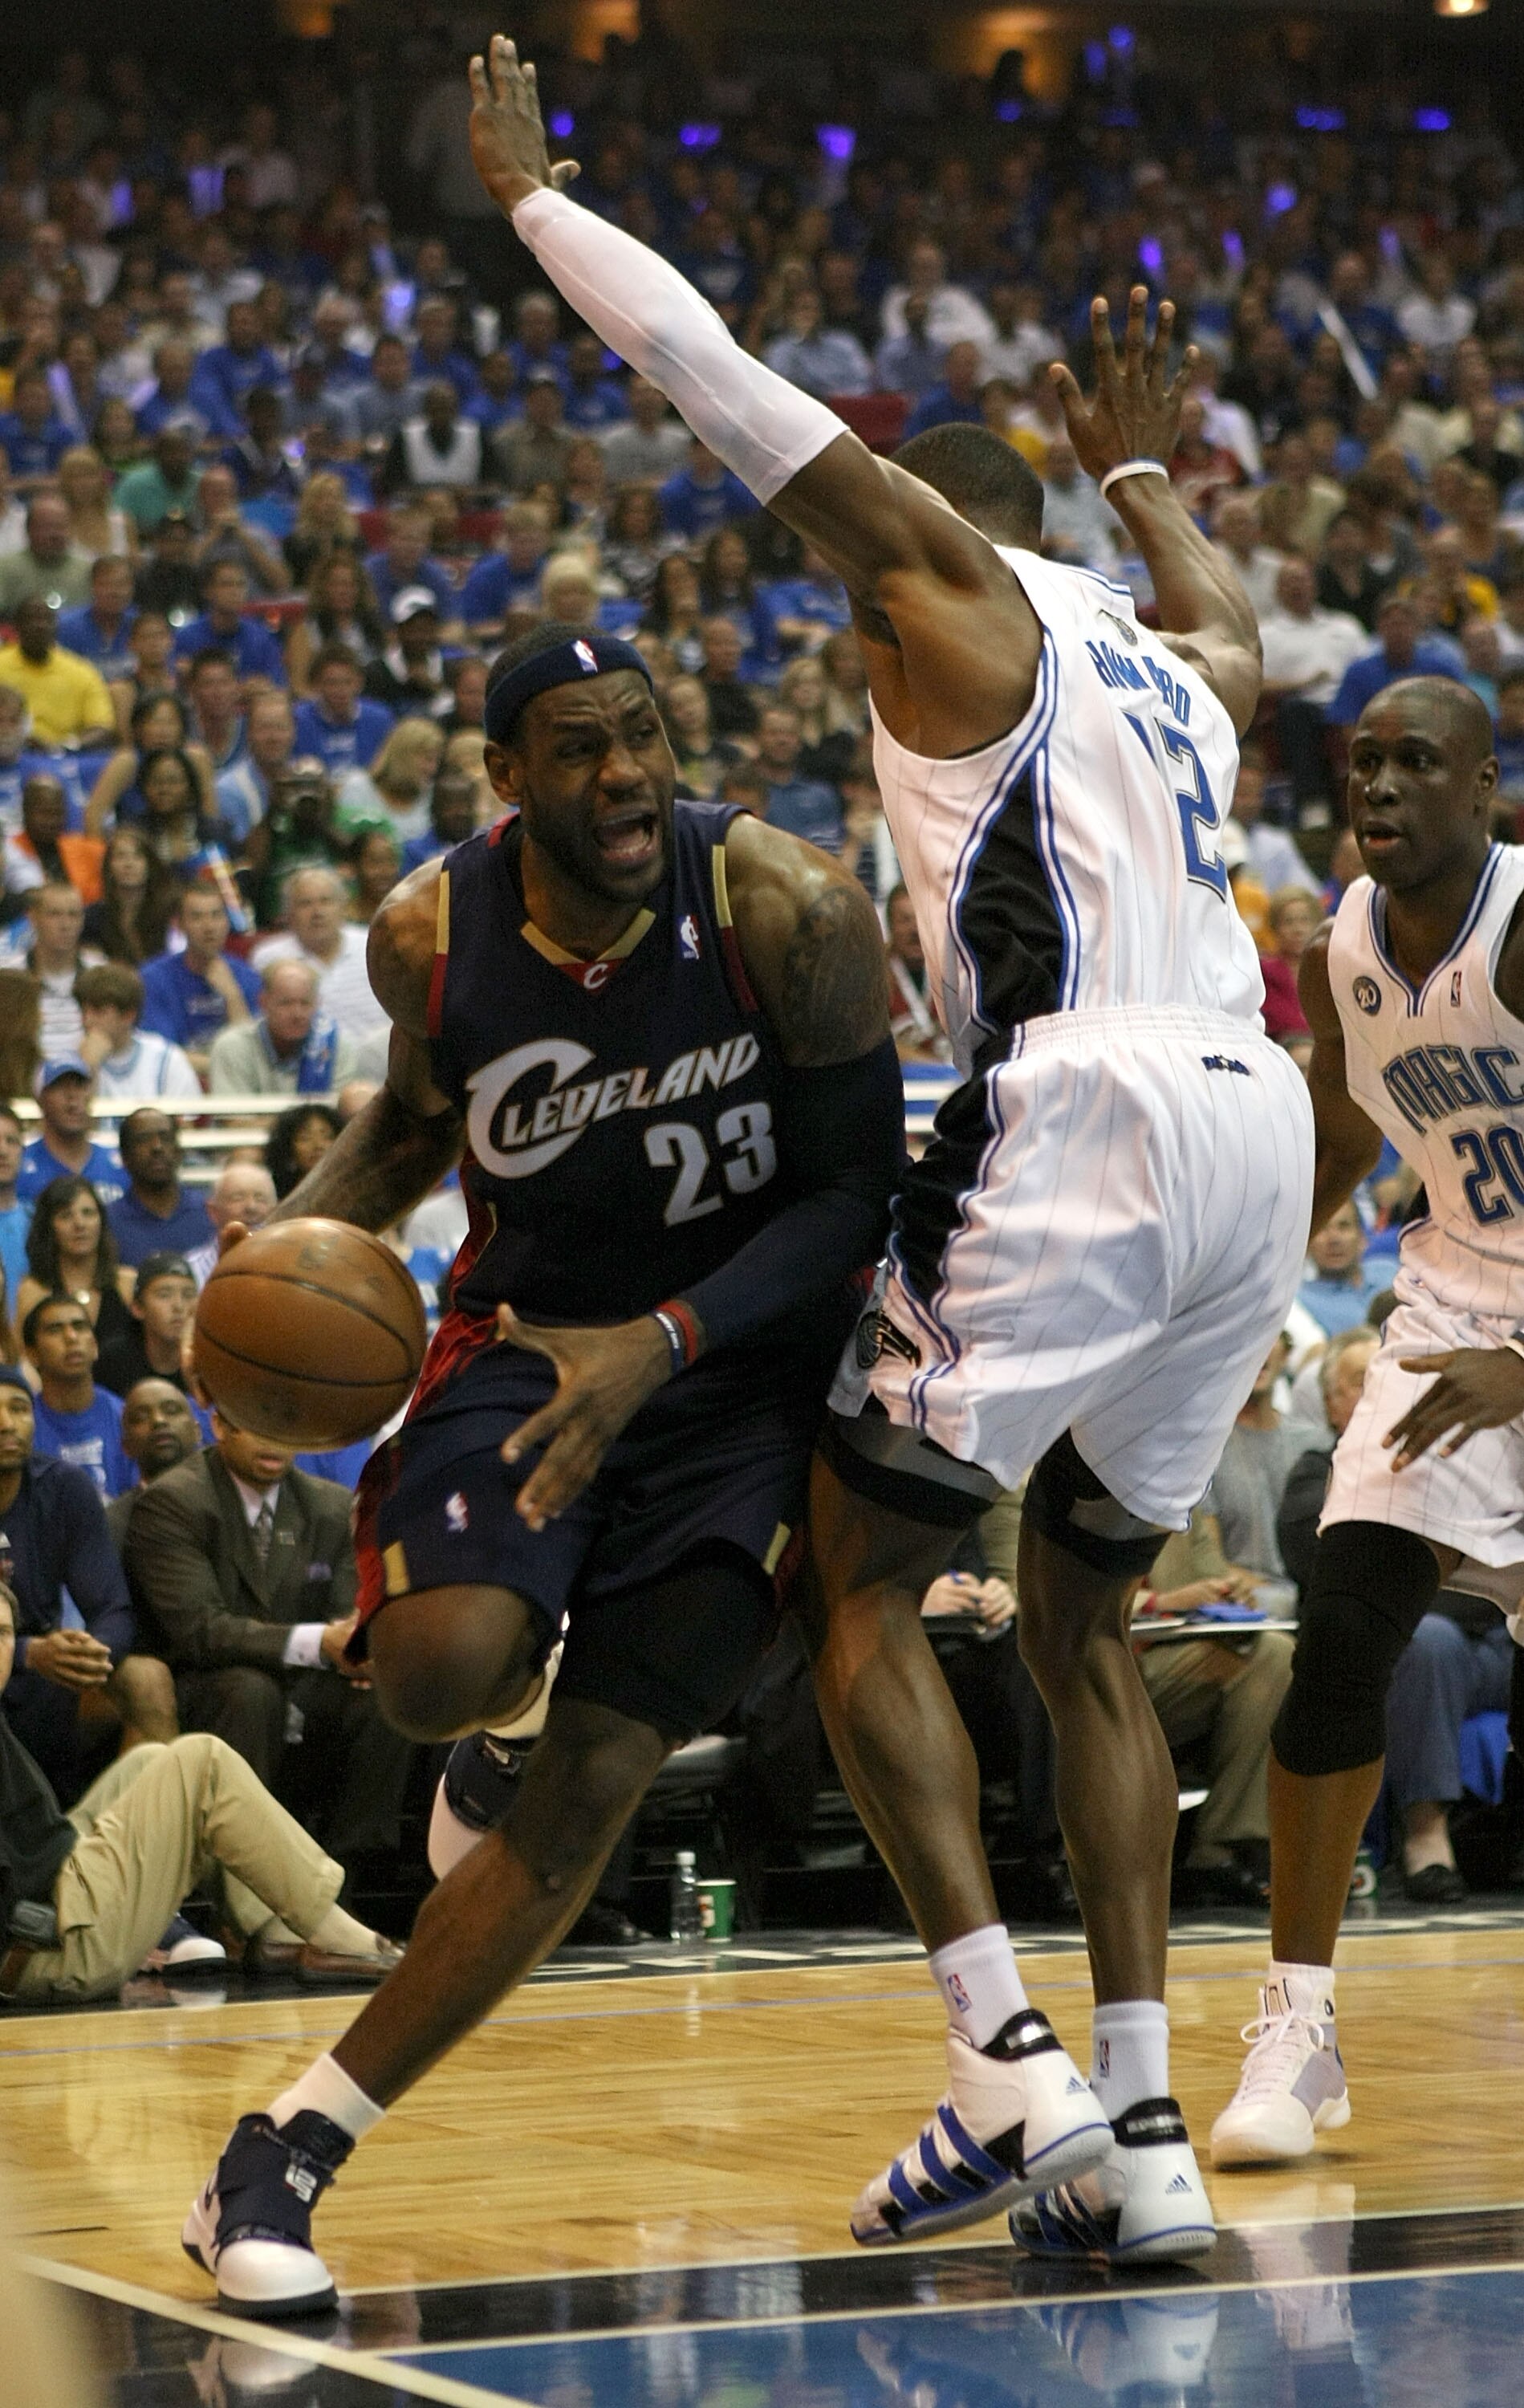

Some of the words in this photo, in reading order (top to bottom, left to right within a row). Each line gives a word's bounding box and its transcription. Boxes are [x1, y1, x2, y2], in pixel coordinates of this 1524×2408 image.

[583, 963, 608, 989] C
[1357, 986, 1377, 1009] 20
[1380, 1044, 1524, 1137] MAGIC
[644, 1100, 778, 1226] 23
[1449, 1123, 1524, 1226] 20
